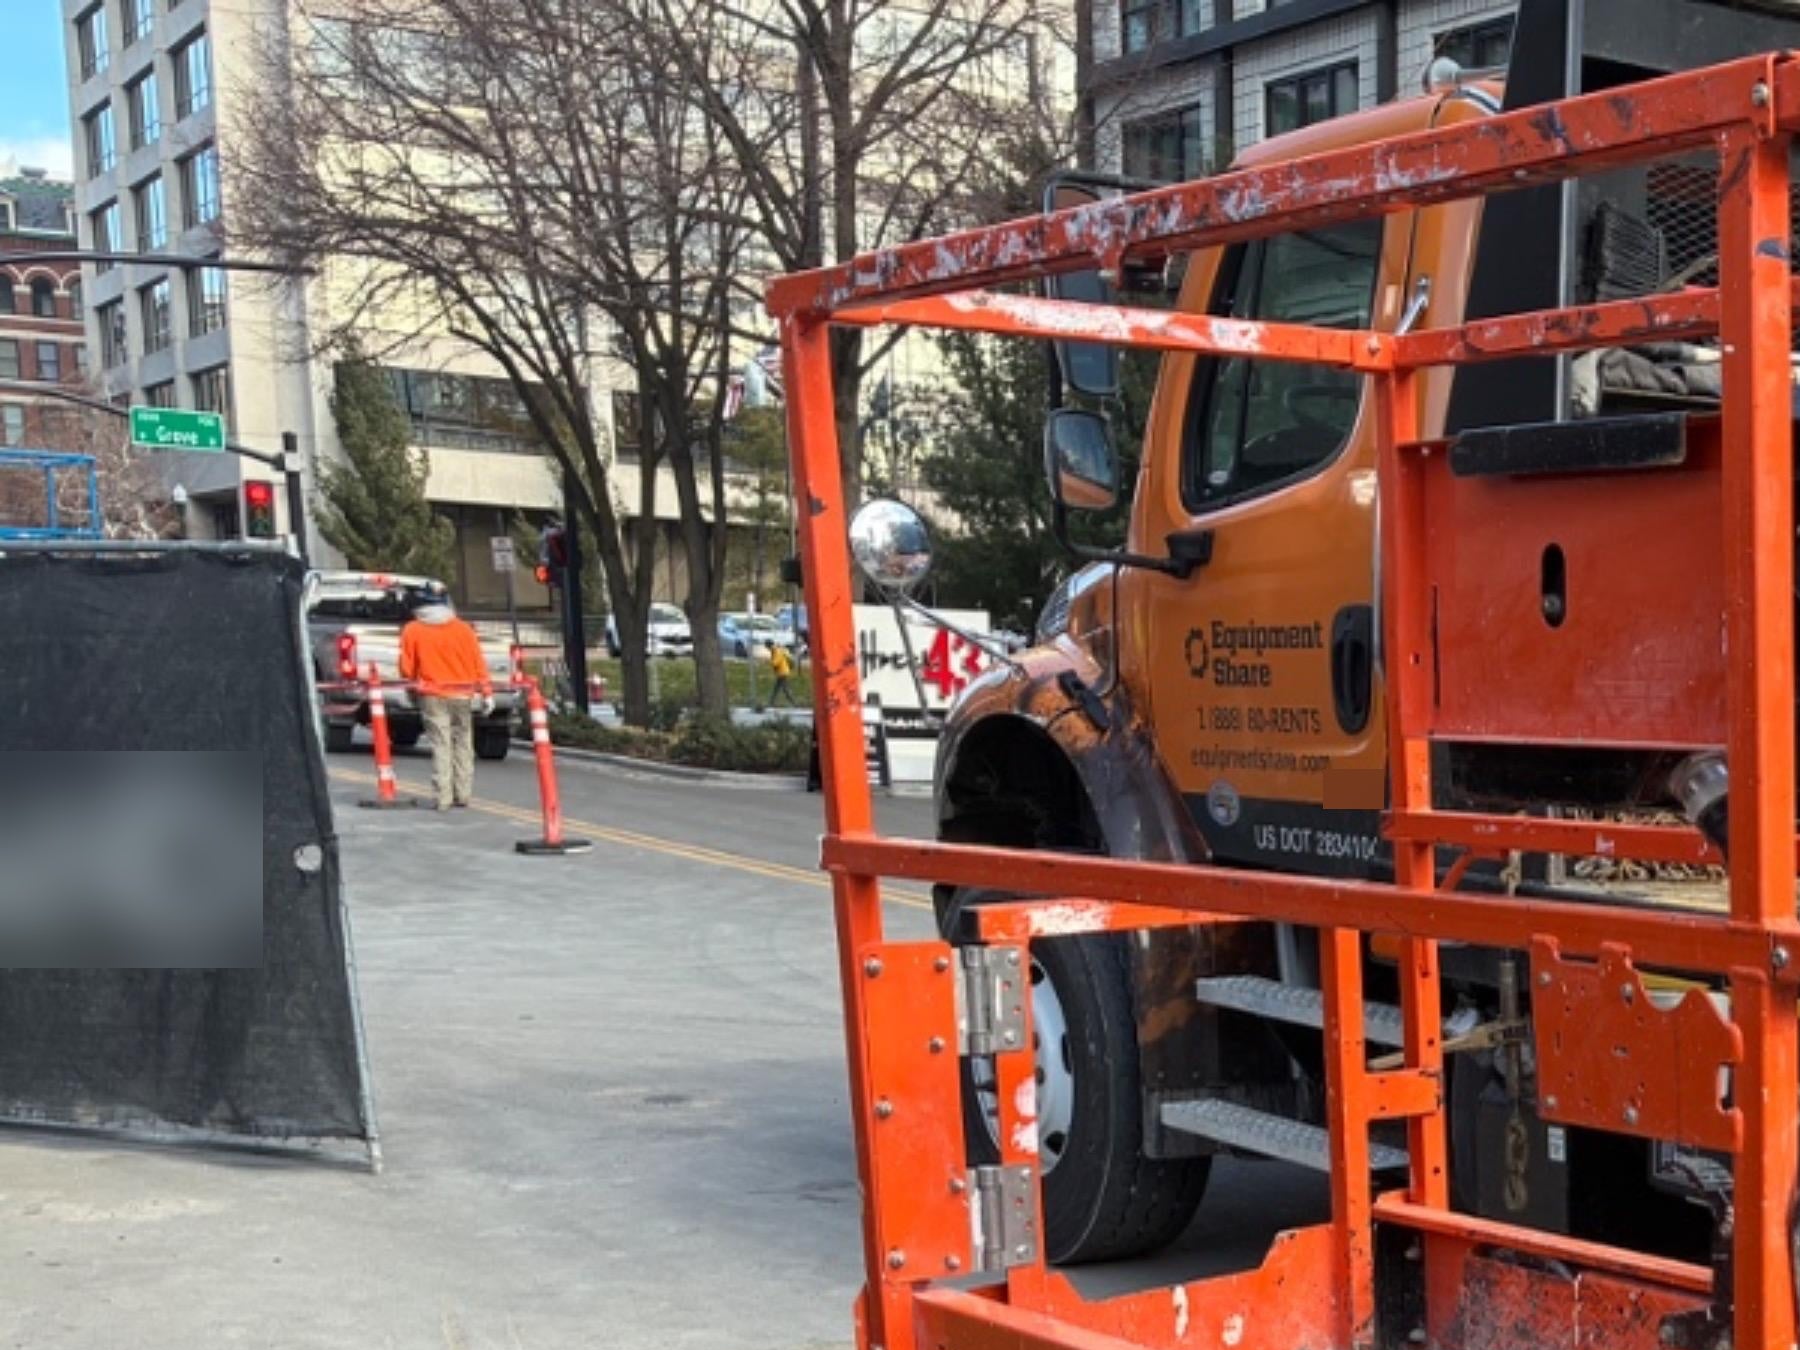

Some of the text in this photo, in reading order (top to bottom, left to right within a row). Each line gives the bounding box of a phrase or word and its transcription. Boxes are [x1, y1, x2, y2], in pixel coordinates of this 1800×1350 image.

[155, 425, 199, 446] Grove
[1212, 619, 1324, 656] Equipment
[1214, 657, 1272, 687] Share
[1196, 707, 1206, 730] 1
[1247, 706, 1322, 734] 80-RENTS
[1191, 743, 1330, 772] equipmentshare.com
[1254, 824, 1276, 851] US
[1280, 827, 1313, 853] DOT
